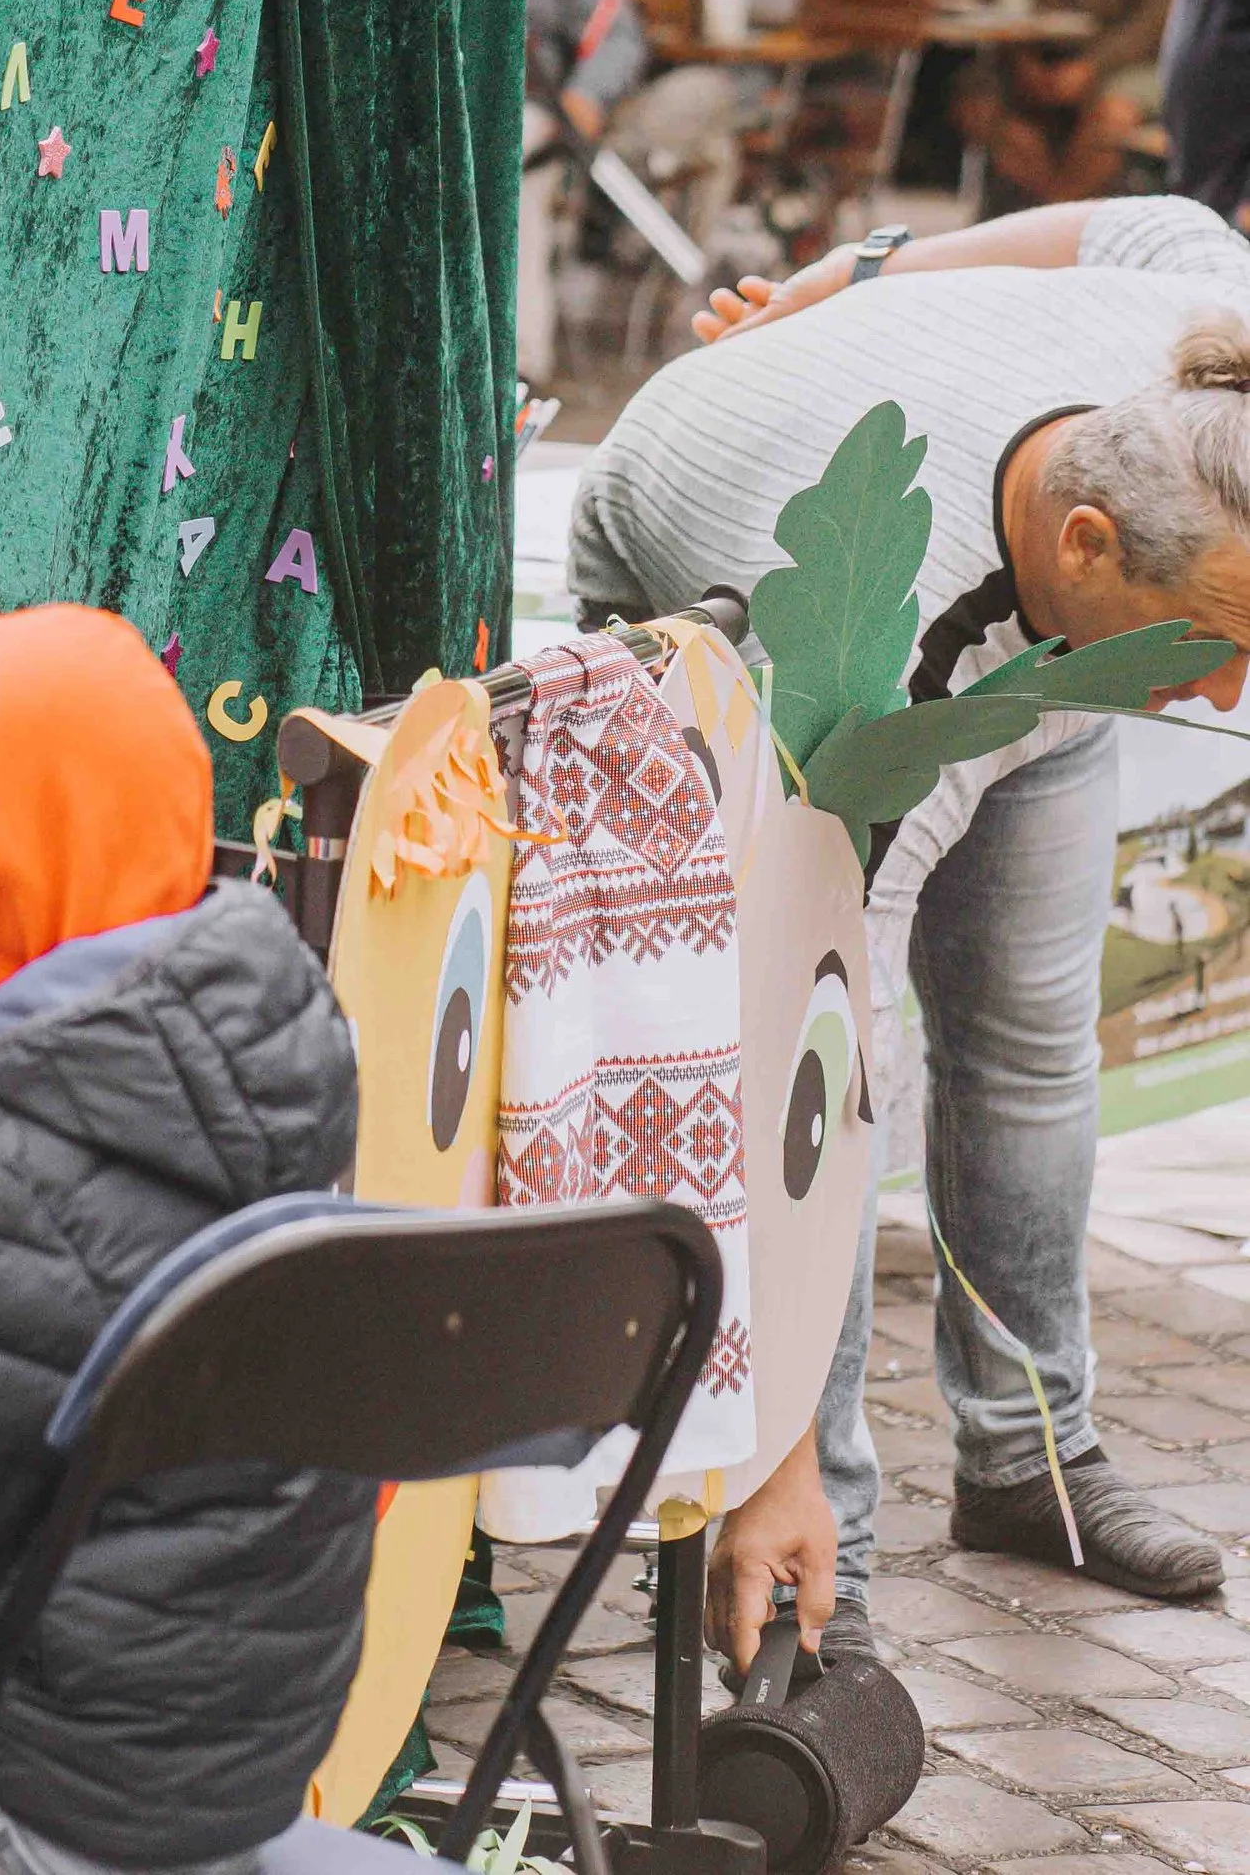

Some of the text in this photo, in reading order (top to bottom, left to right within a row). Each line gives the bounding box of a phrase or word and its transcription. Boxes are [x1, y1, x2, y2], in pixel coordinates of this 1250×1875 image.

[100, 210, 149, 272] M
[220, 300, 262, 360] H
[265, 528, 318, 594] A
[207, 680, 268, 742] C
[755, 1678, 771, 1704] SONY
